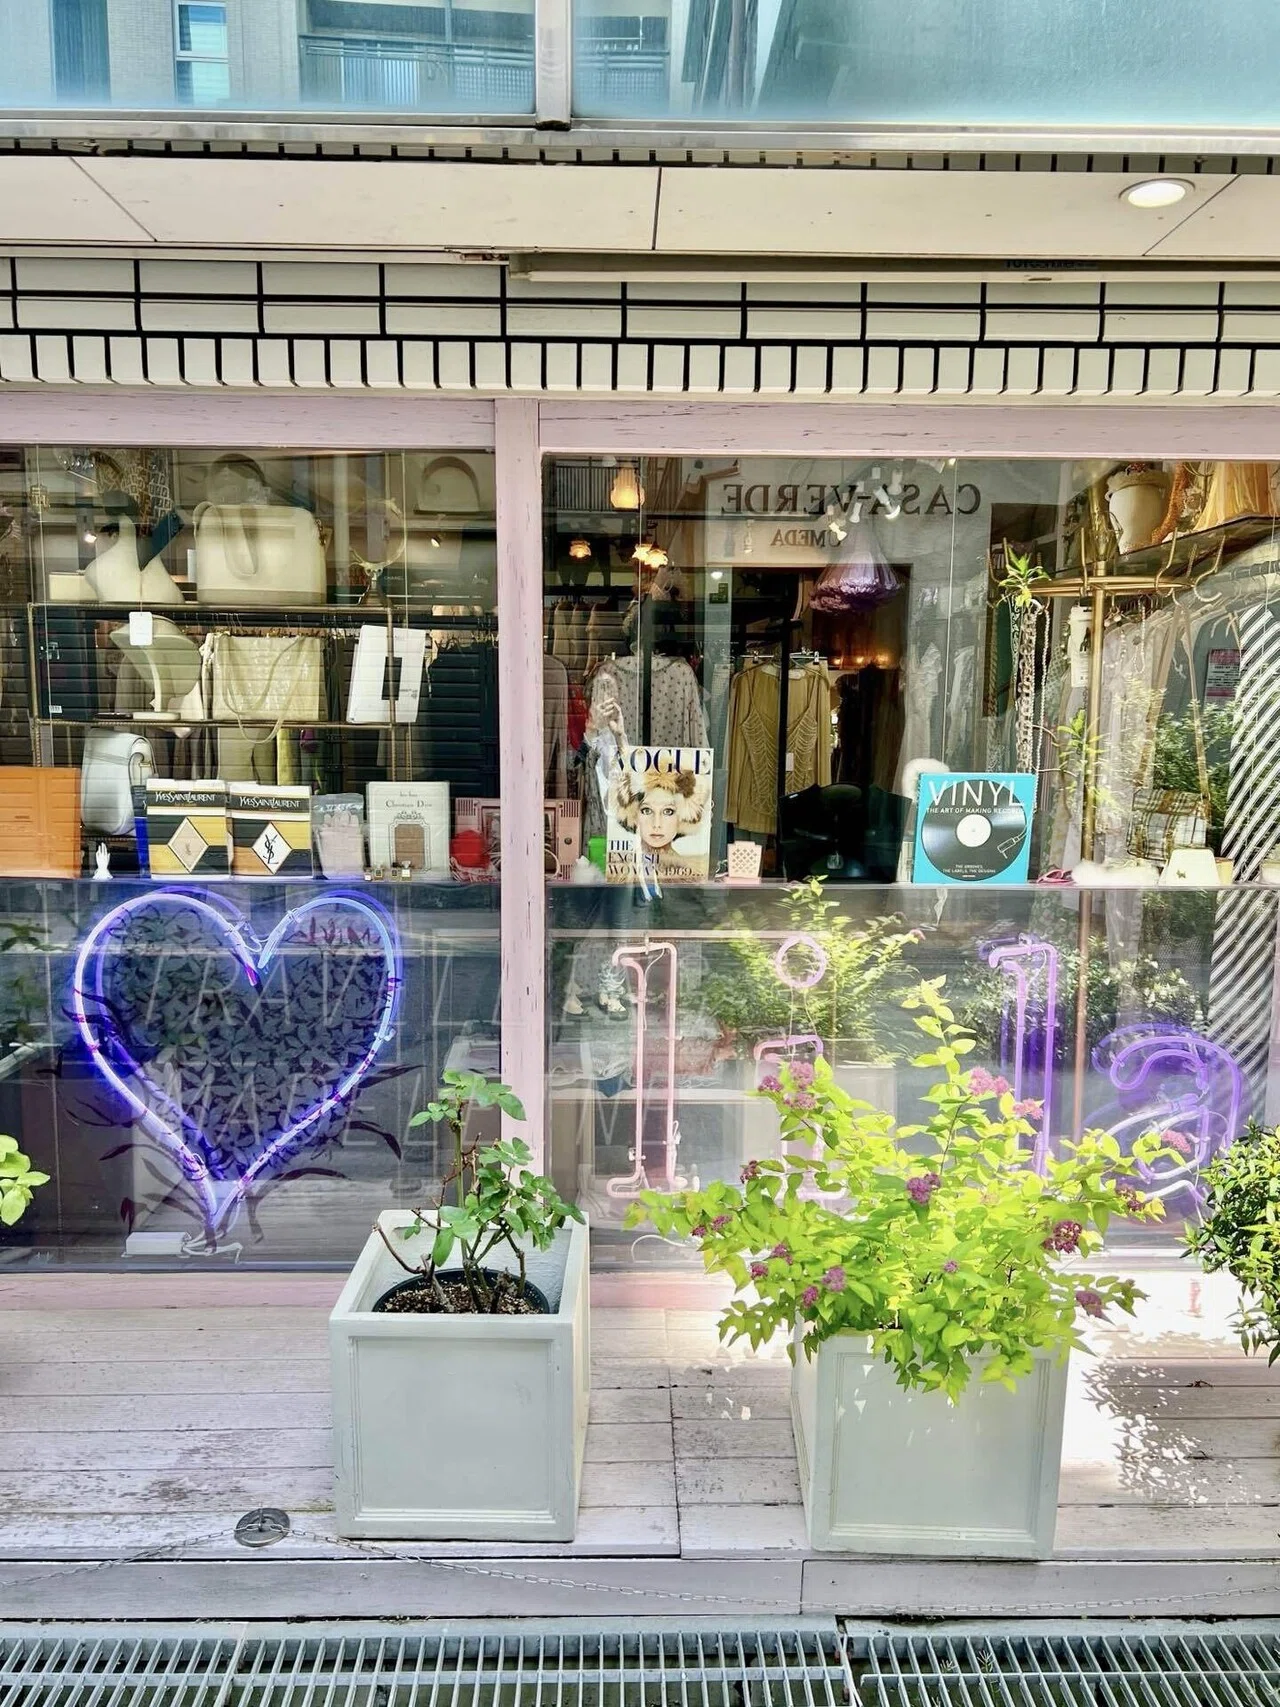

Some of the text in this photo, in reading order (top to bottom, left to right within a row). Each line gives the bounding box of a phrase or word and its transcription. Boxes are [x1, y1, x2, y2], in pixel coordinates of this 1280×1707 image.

[928, 780, 1025, 806] VINYL
[610, 840, 634, 851] THE
[608, 852, 660, 864] ENGLSH
